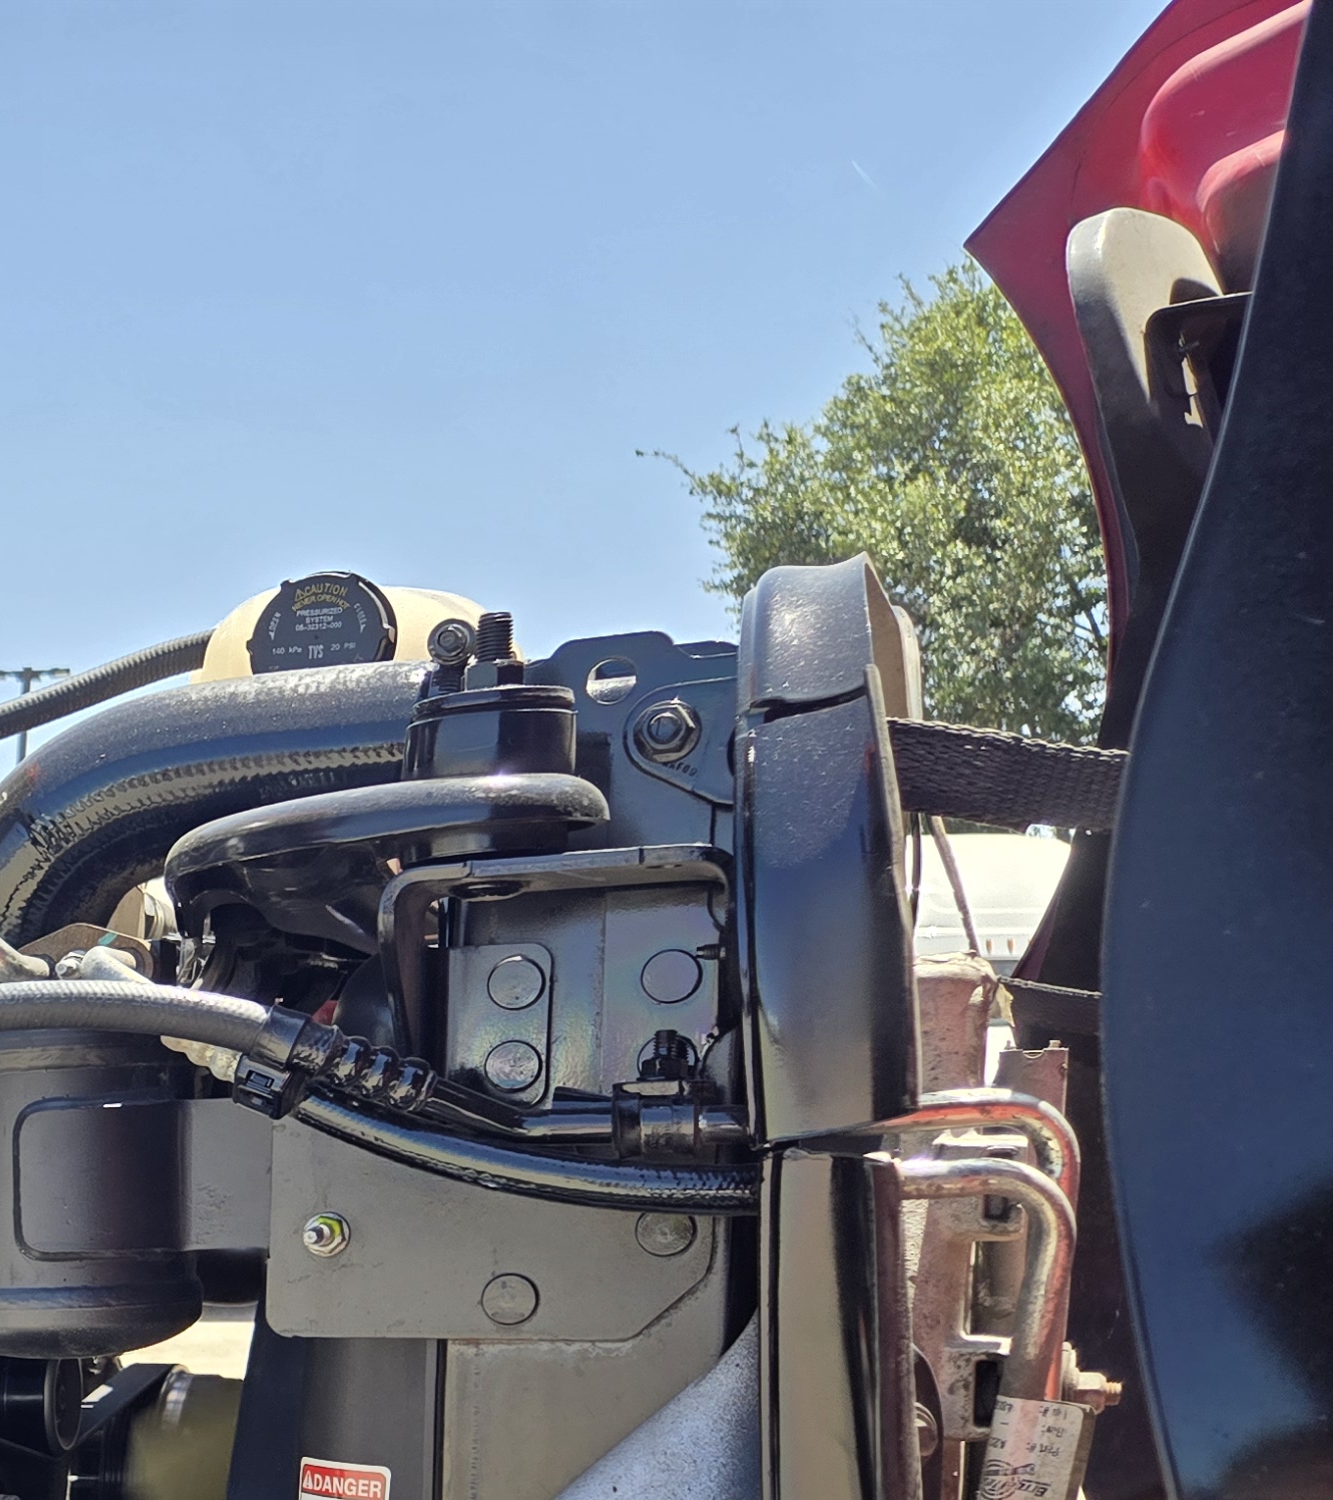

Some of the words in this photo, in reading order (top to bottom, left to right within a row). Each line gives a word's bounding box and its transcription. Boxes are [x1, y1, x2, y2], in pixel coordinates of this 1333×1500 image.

[305, 582, 349, 597] CAUTION
[292, 596, 317, 612] NEVER
[317, 594, 337, 604] OPEN
[335, 597, 350, 609] HOT
[296, 607, 343, 617] PRESSURIZED
[305, 616, 334, 624] SYSTEM
[308, 645, 323, 659] TVS
[313, 1476, 382, 1498] DANGER
